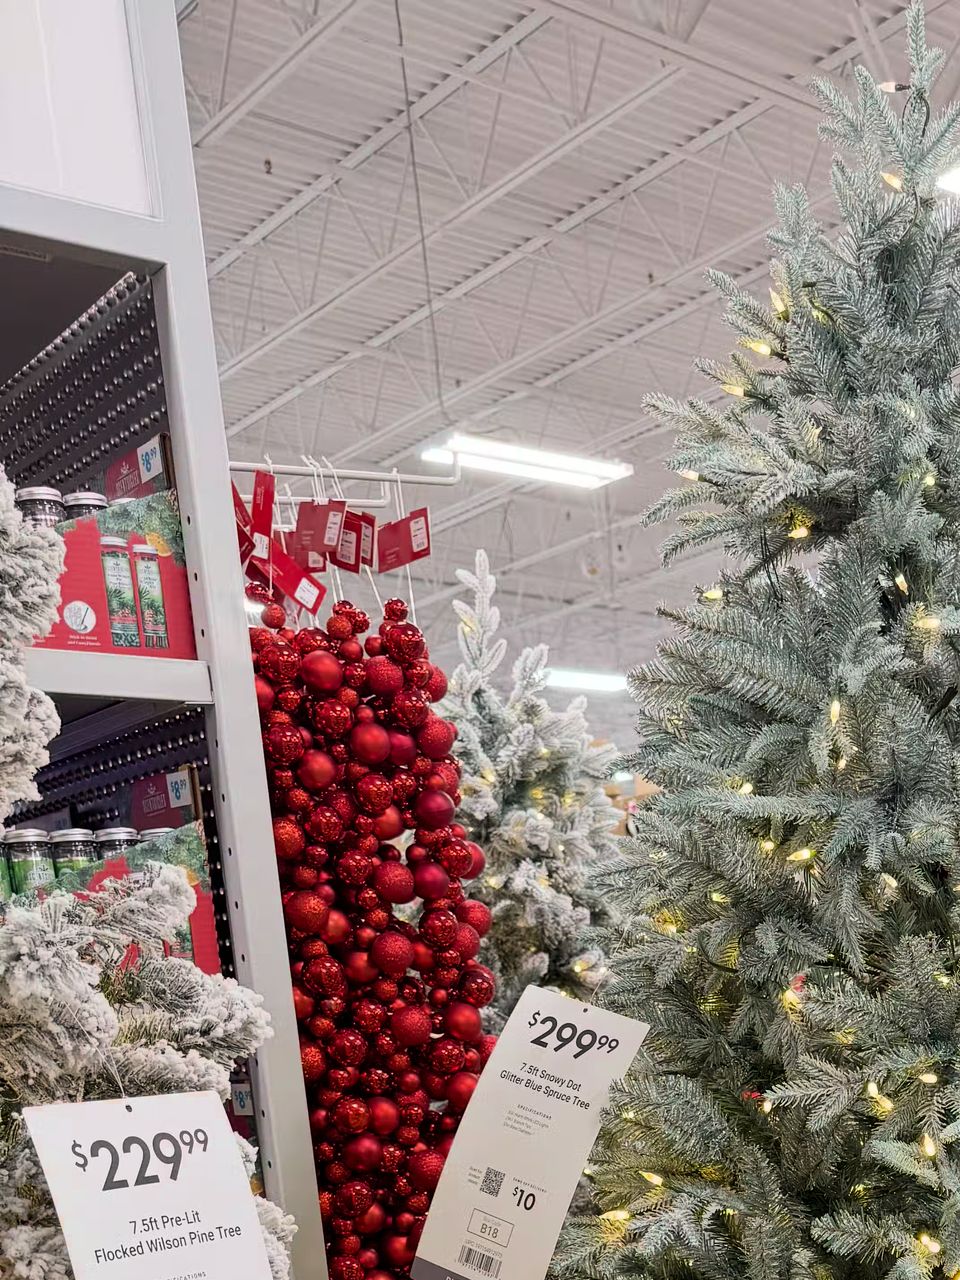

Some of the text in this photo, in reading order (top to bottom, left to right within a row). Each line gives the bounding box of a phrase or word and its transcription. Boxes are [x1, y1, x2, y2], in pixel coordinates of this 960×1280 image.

[499, 1069, 590, 1110] Glitter Blue Spruce Tree
[520, 1062, 582, 1092] 7.5ft Snowy Dot
[512, 1186, 536, 1211] $10
[129, 1210, 201, 1235] 7.5ft Pre-Lit
[480, 1223, 499, 1239] B18
[94, 1225, 242, 1263] Flocked Wilson Pine Tree
